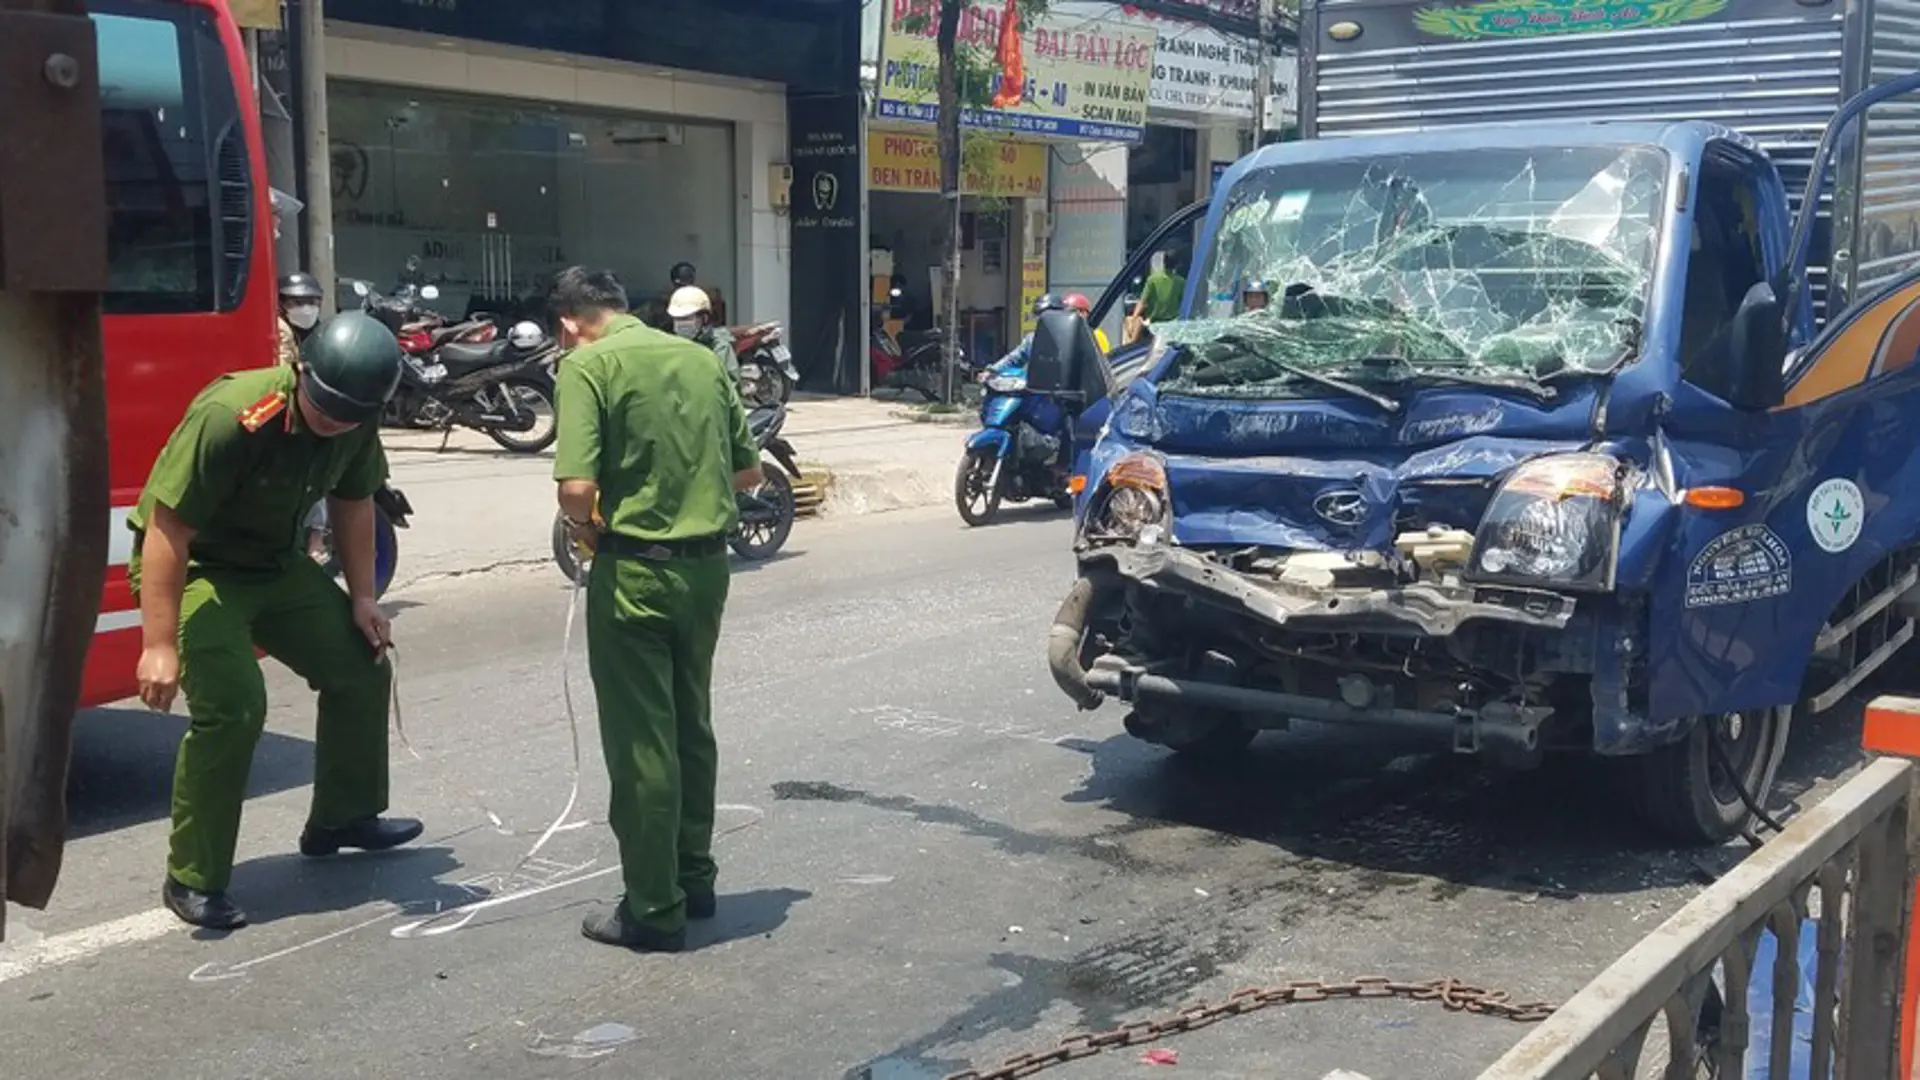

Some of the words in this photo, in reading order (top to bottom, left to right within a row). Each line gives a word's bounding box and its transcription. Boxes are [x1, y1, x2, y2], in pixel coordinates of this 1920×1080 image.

[1169, 67, 1211, 86] TRANH
[1083, 81, 1096, 97] IN
[1082, 103, 1114, 121] SCAN
